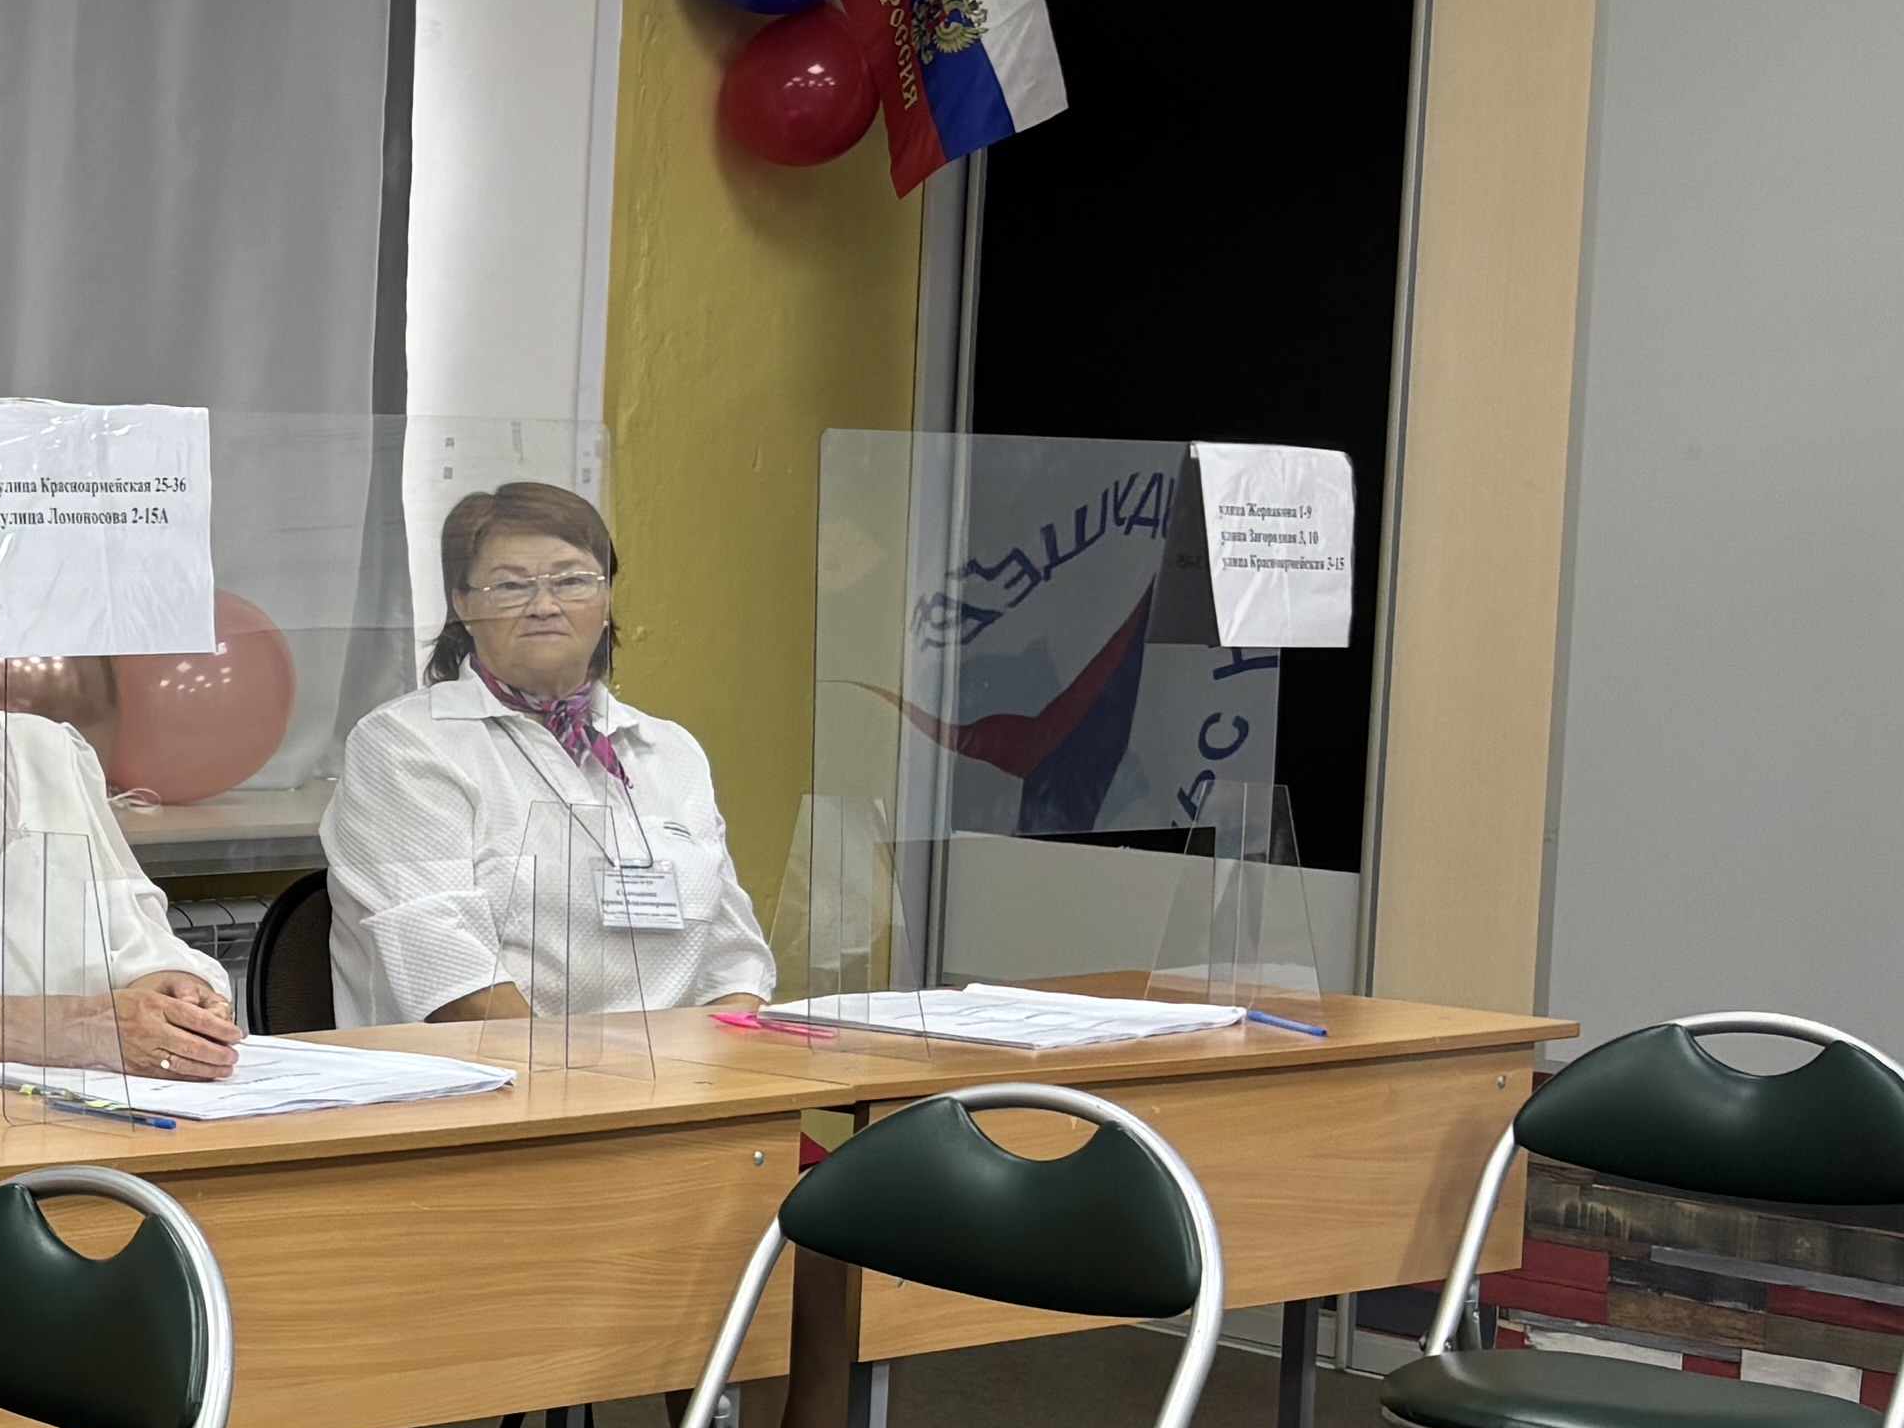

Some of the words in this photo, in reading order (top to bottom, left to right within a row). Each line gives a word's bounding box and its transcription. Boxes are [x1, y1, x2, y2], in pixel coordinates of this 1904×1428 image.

[41, 477, 151, 497] Красноармейская
[155, 478, 187, 493] 25-36
[0, 513, 44, 529] улица
[47, 508, 128, 526] Ломоносова
[131, 508, 169, 525] 2-15А
